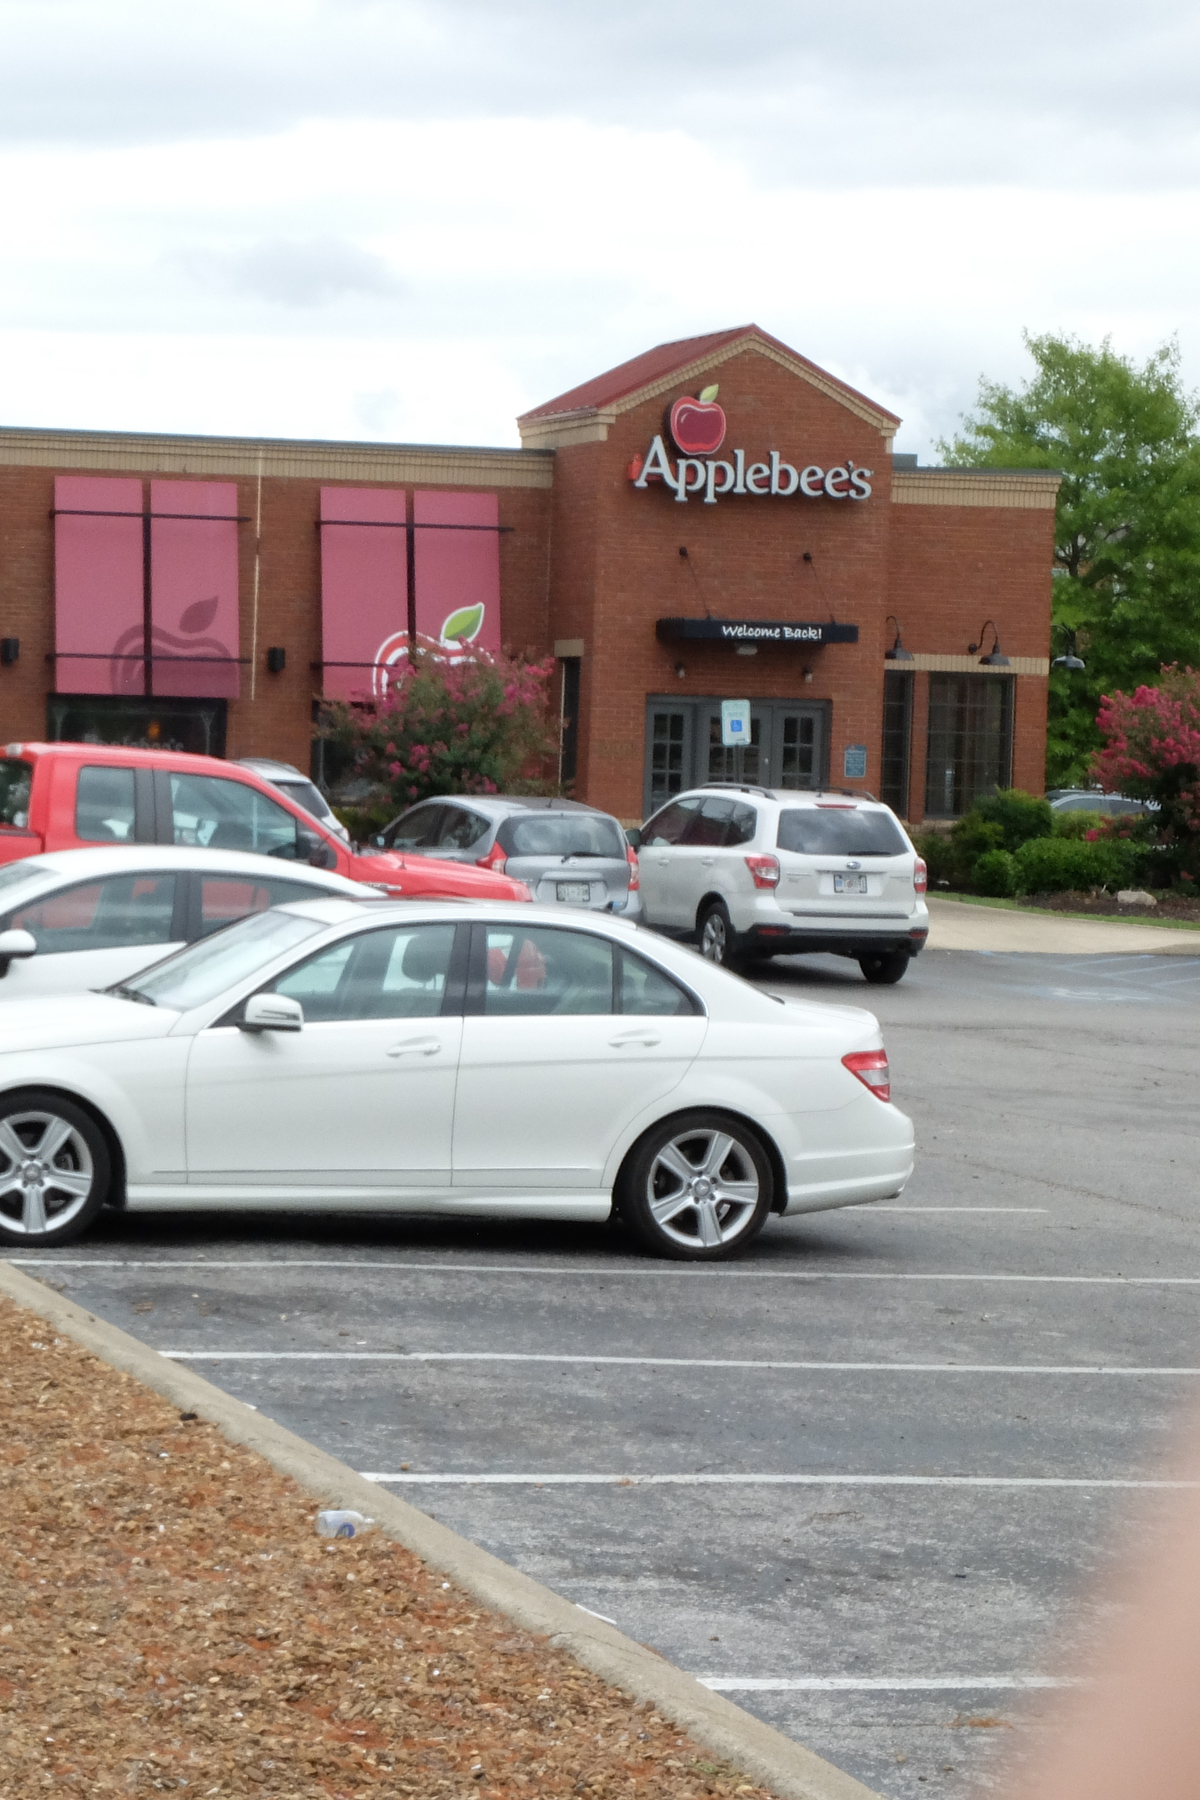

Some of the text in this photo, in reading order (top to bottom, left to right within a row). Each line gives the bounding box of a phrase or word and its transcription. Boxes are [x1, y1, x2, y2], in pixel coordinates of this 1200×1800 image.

[634, 435, 873, 503] Applebee's
[722, 625, 822, 639] Welcome Back!
